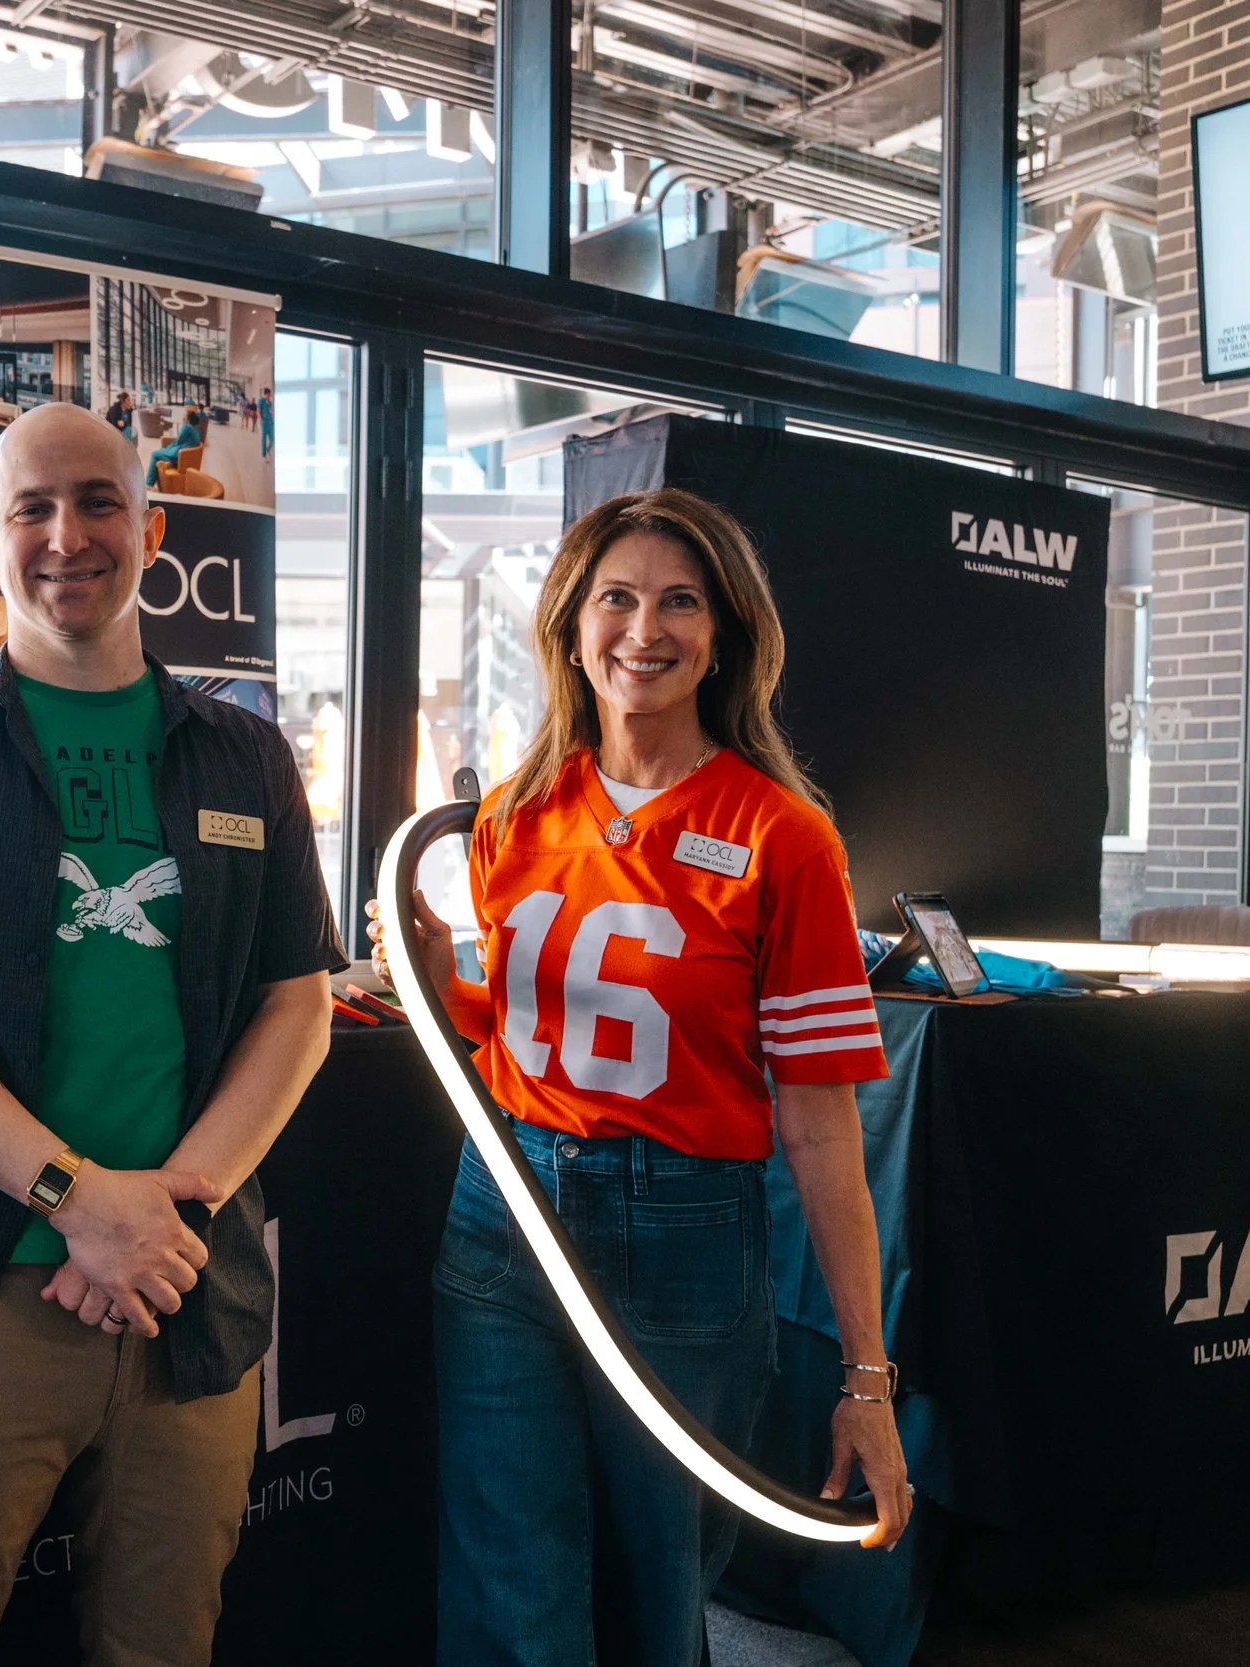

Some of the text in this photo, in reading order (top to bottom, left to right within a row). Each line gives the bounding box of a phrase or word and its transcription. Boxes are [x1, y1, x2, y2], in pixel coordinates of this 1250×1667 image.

[964, 560, 1020, 579] ILLUMINATE
[1021, 571, 1041, 583] THE
[138, 550, 255, 623] OCL
[44, 746, 158, 765] ADELP
[225, 817, 251, 834] OCL
[223, 834, 255, 843] CHRONISTER
[684, 852, 735, 871] MARYANN CASSIDY
[707, 843, 733, 862] OCL
[500, 890, 687, 1100] 16
[238, 1467, 334, 1527] HTING
